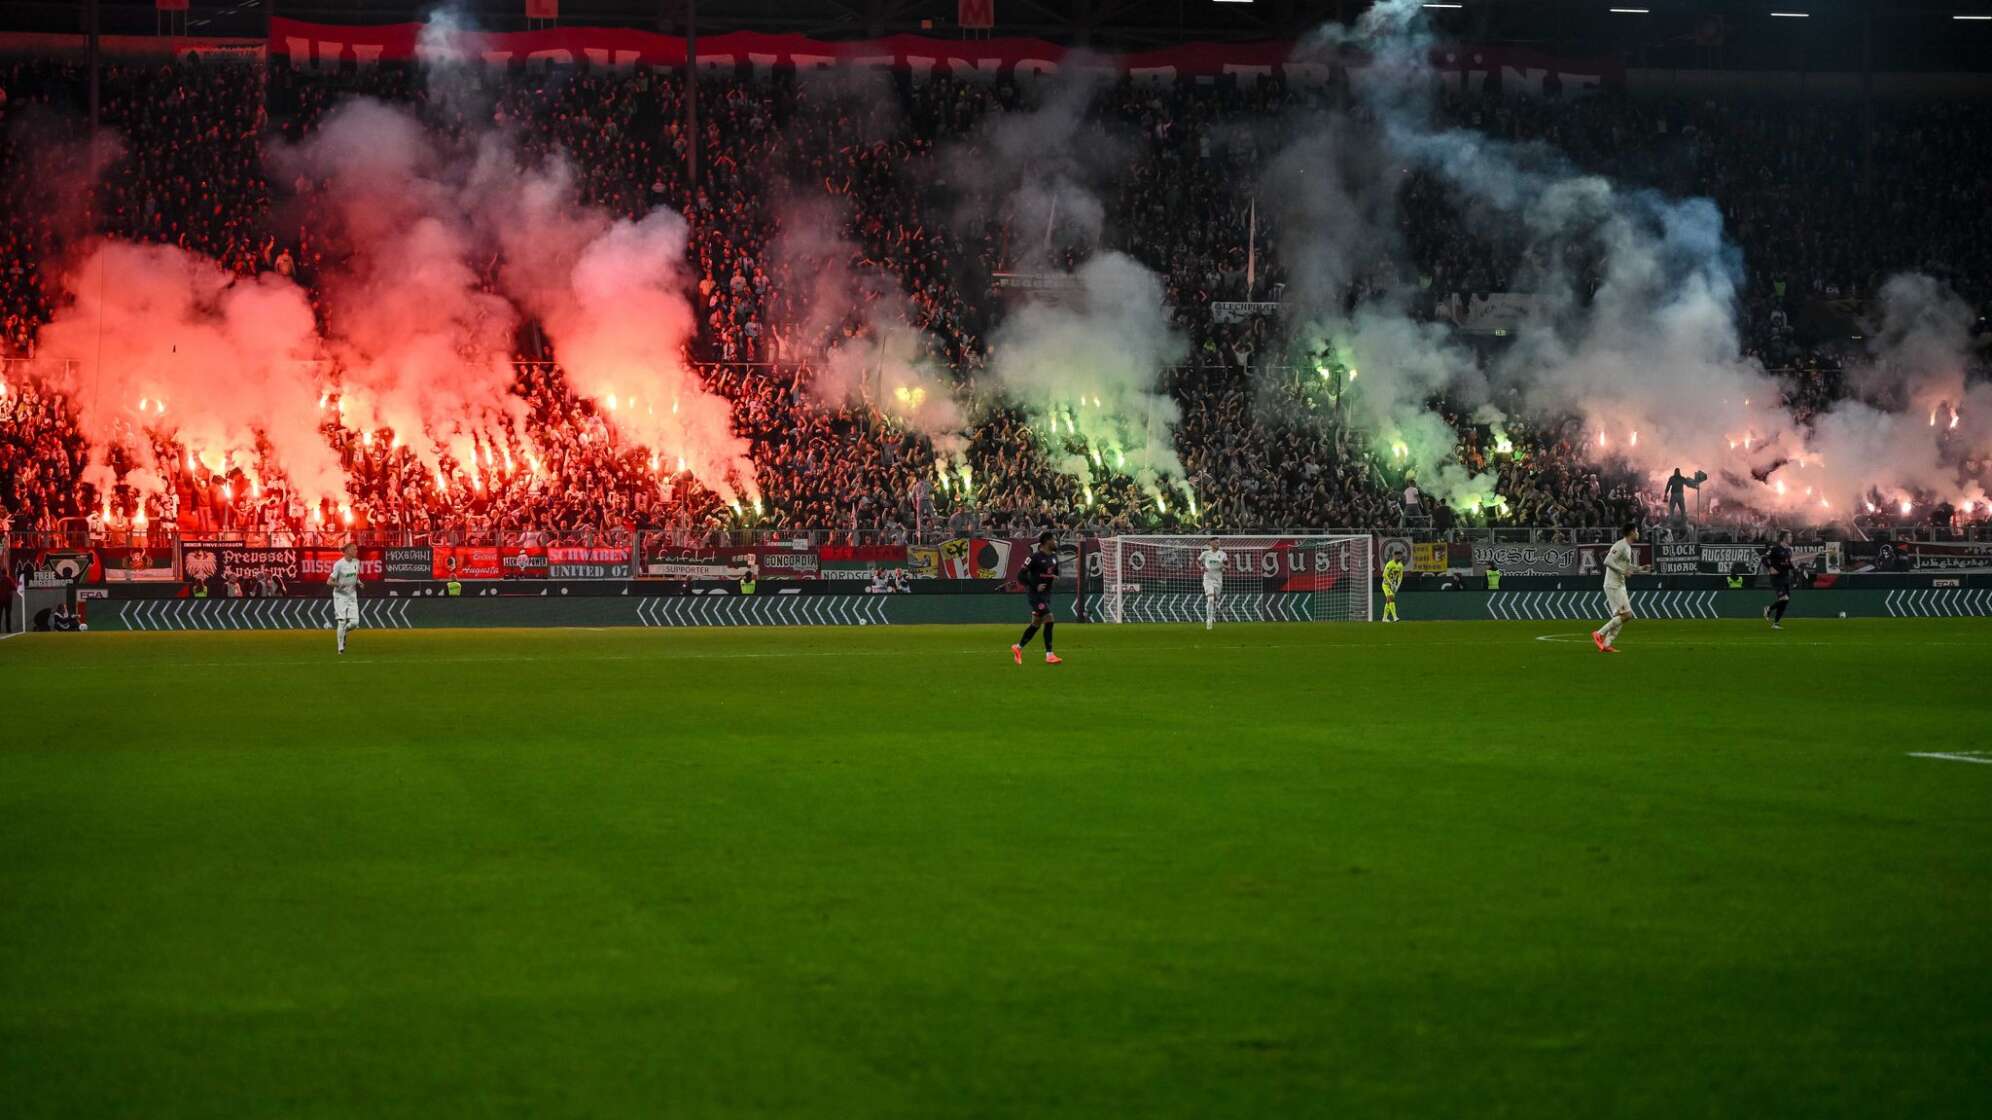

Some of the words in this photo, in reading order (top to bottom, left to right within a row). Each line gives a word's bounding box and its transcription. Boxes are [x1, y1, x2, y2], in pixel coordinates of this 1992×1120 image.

[548, 550, 629, 561] SCHWABEN
[1702, 549, 1749, 561] AUGSBURG
[302, 560, 383, 573] DISSNTS
[550, 565, 604, 577] UNITED
[612, 565, 629, 577] 07
